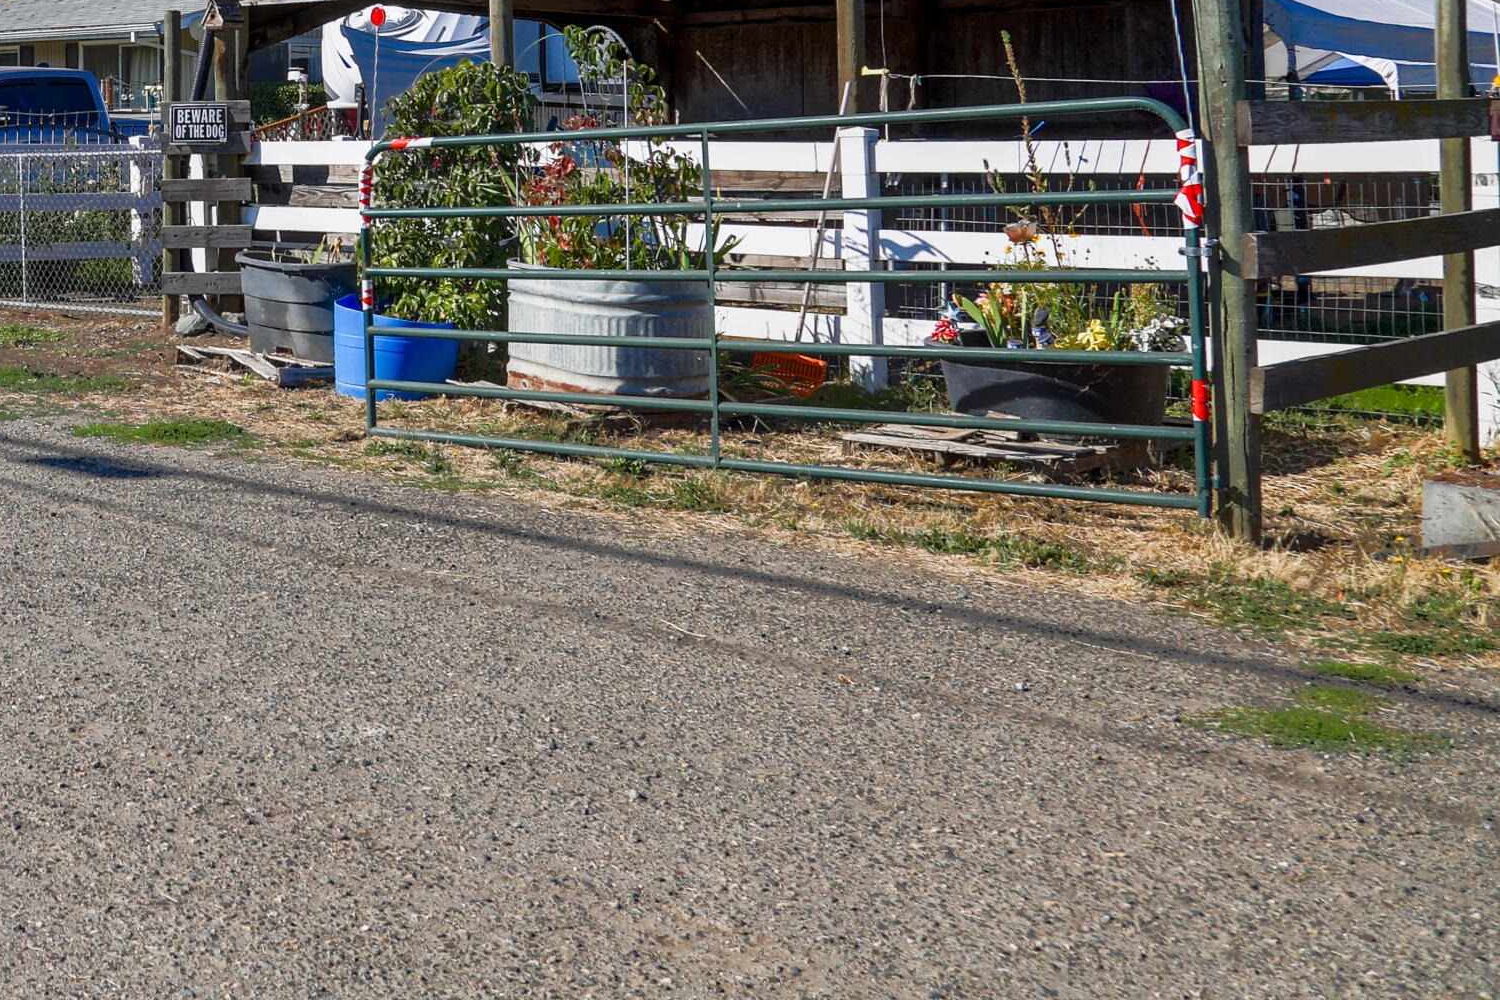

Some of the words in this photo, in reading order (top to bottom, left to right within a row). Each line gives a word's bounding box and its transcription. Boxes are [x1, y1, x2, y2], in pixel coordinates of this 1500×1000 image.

[177, 109, 222, 123] BEWARE
[175, 124, 187, 138] OF
[188, 124, 205, 138] THE
[206, 124, 225, 138] DOG
